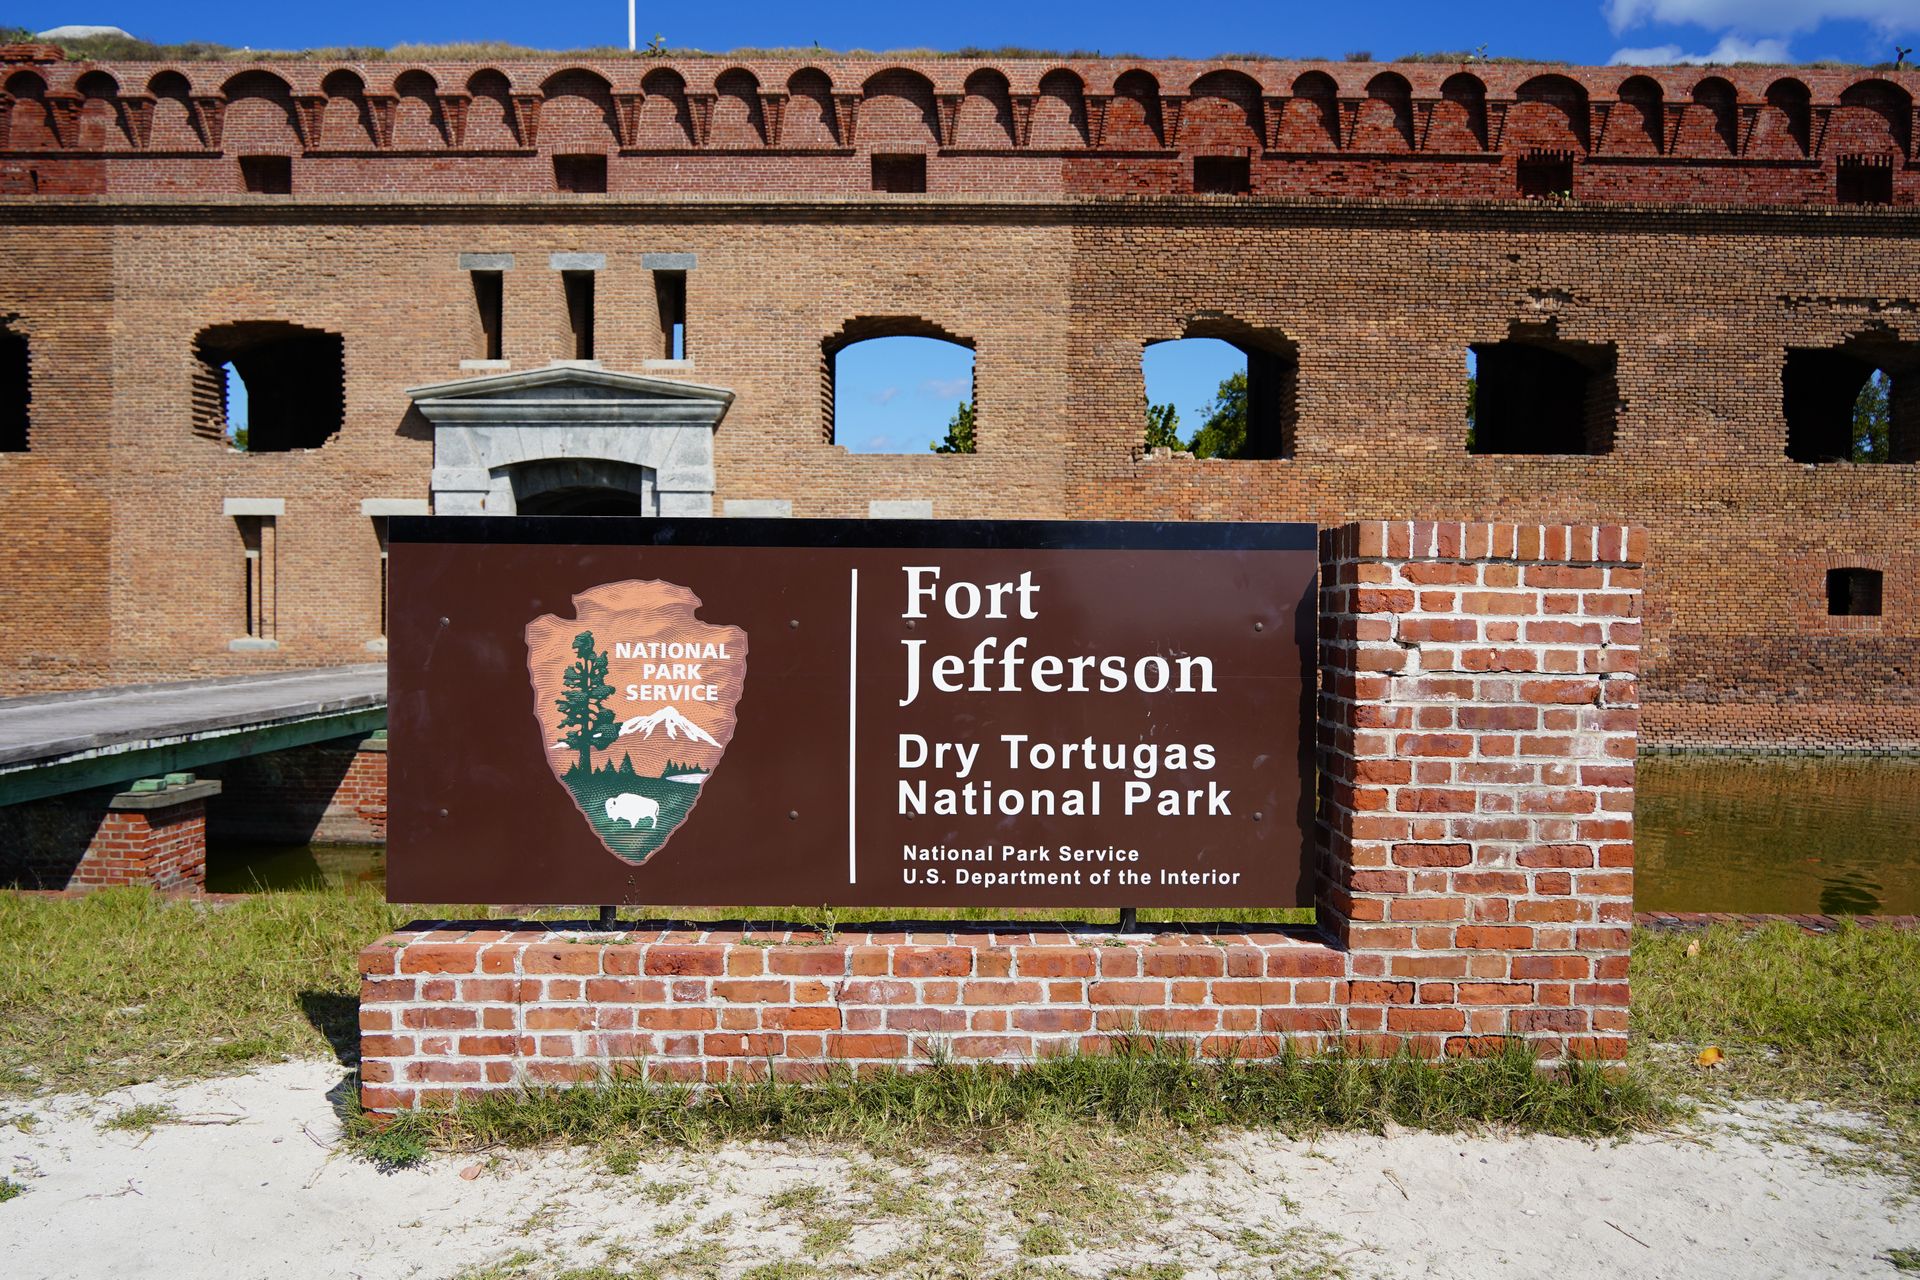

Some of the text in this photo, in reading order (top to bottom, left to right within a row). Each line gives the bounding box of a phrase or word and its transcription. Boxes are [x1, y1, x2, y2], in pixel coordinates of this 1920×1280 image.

[902, 566, 1041, 619] Fort
[614, 642, 731, 660] NATIONAL
[643, 663, 703, 680] PARK
[899, 637, 1217, 706] Jefferson
[625, 684, 719, 701] SERVICE
[898, 734, 1216, 778] Dry Tortugas
[898, 780, 1232, 816] National Park
[903, 845, 1139, 862] National Park Service
[903, 868, 1241, 889] U.S. Department of the Interior
